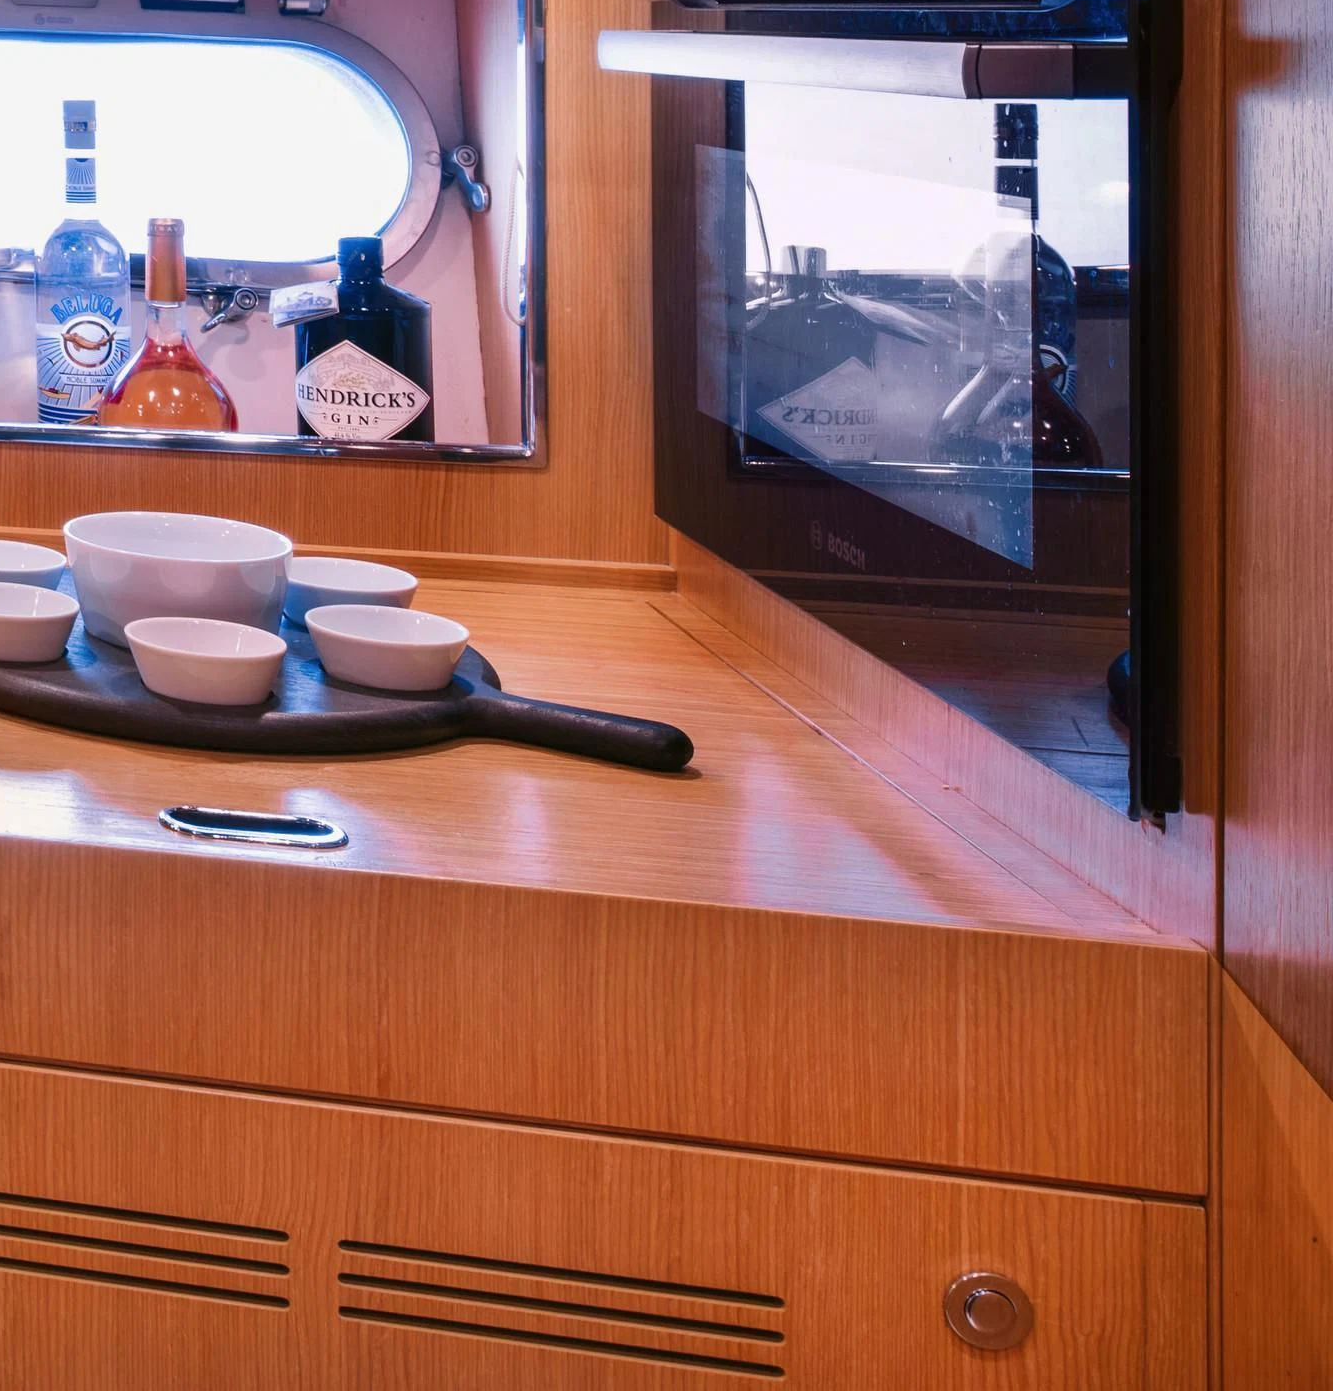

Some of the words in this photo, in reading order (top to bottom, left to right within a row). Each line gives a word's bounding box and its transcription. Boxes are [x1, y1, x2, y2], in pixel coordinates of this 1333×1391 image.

[50, 293, 123, 325] BELUGA
[66, 376, 88, 384] NOBLE
[298, 383, 415, 408] HENDRICK'S
[331, 412, 370, 426] GIN
[828, 532, 865, 570] BOSCH
